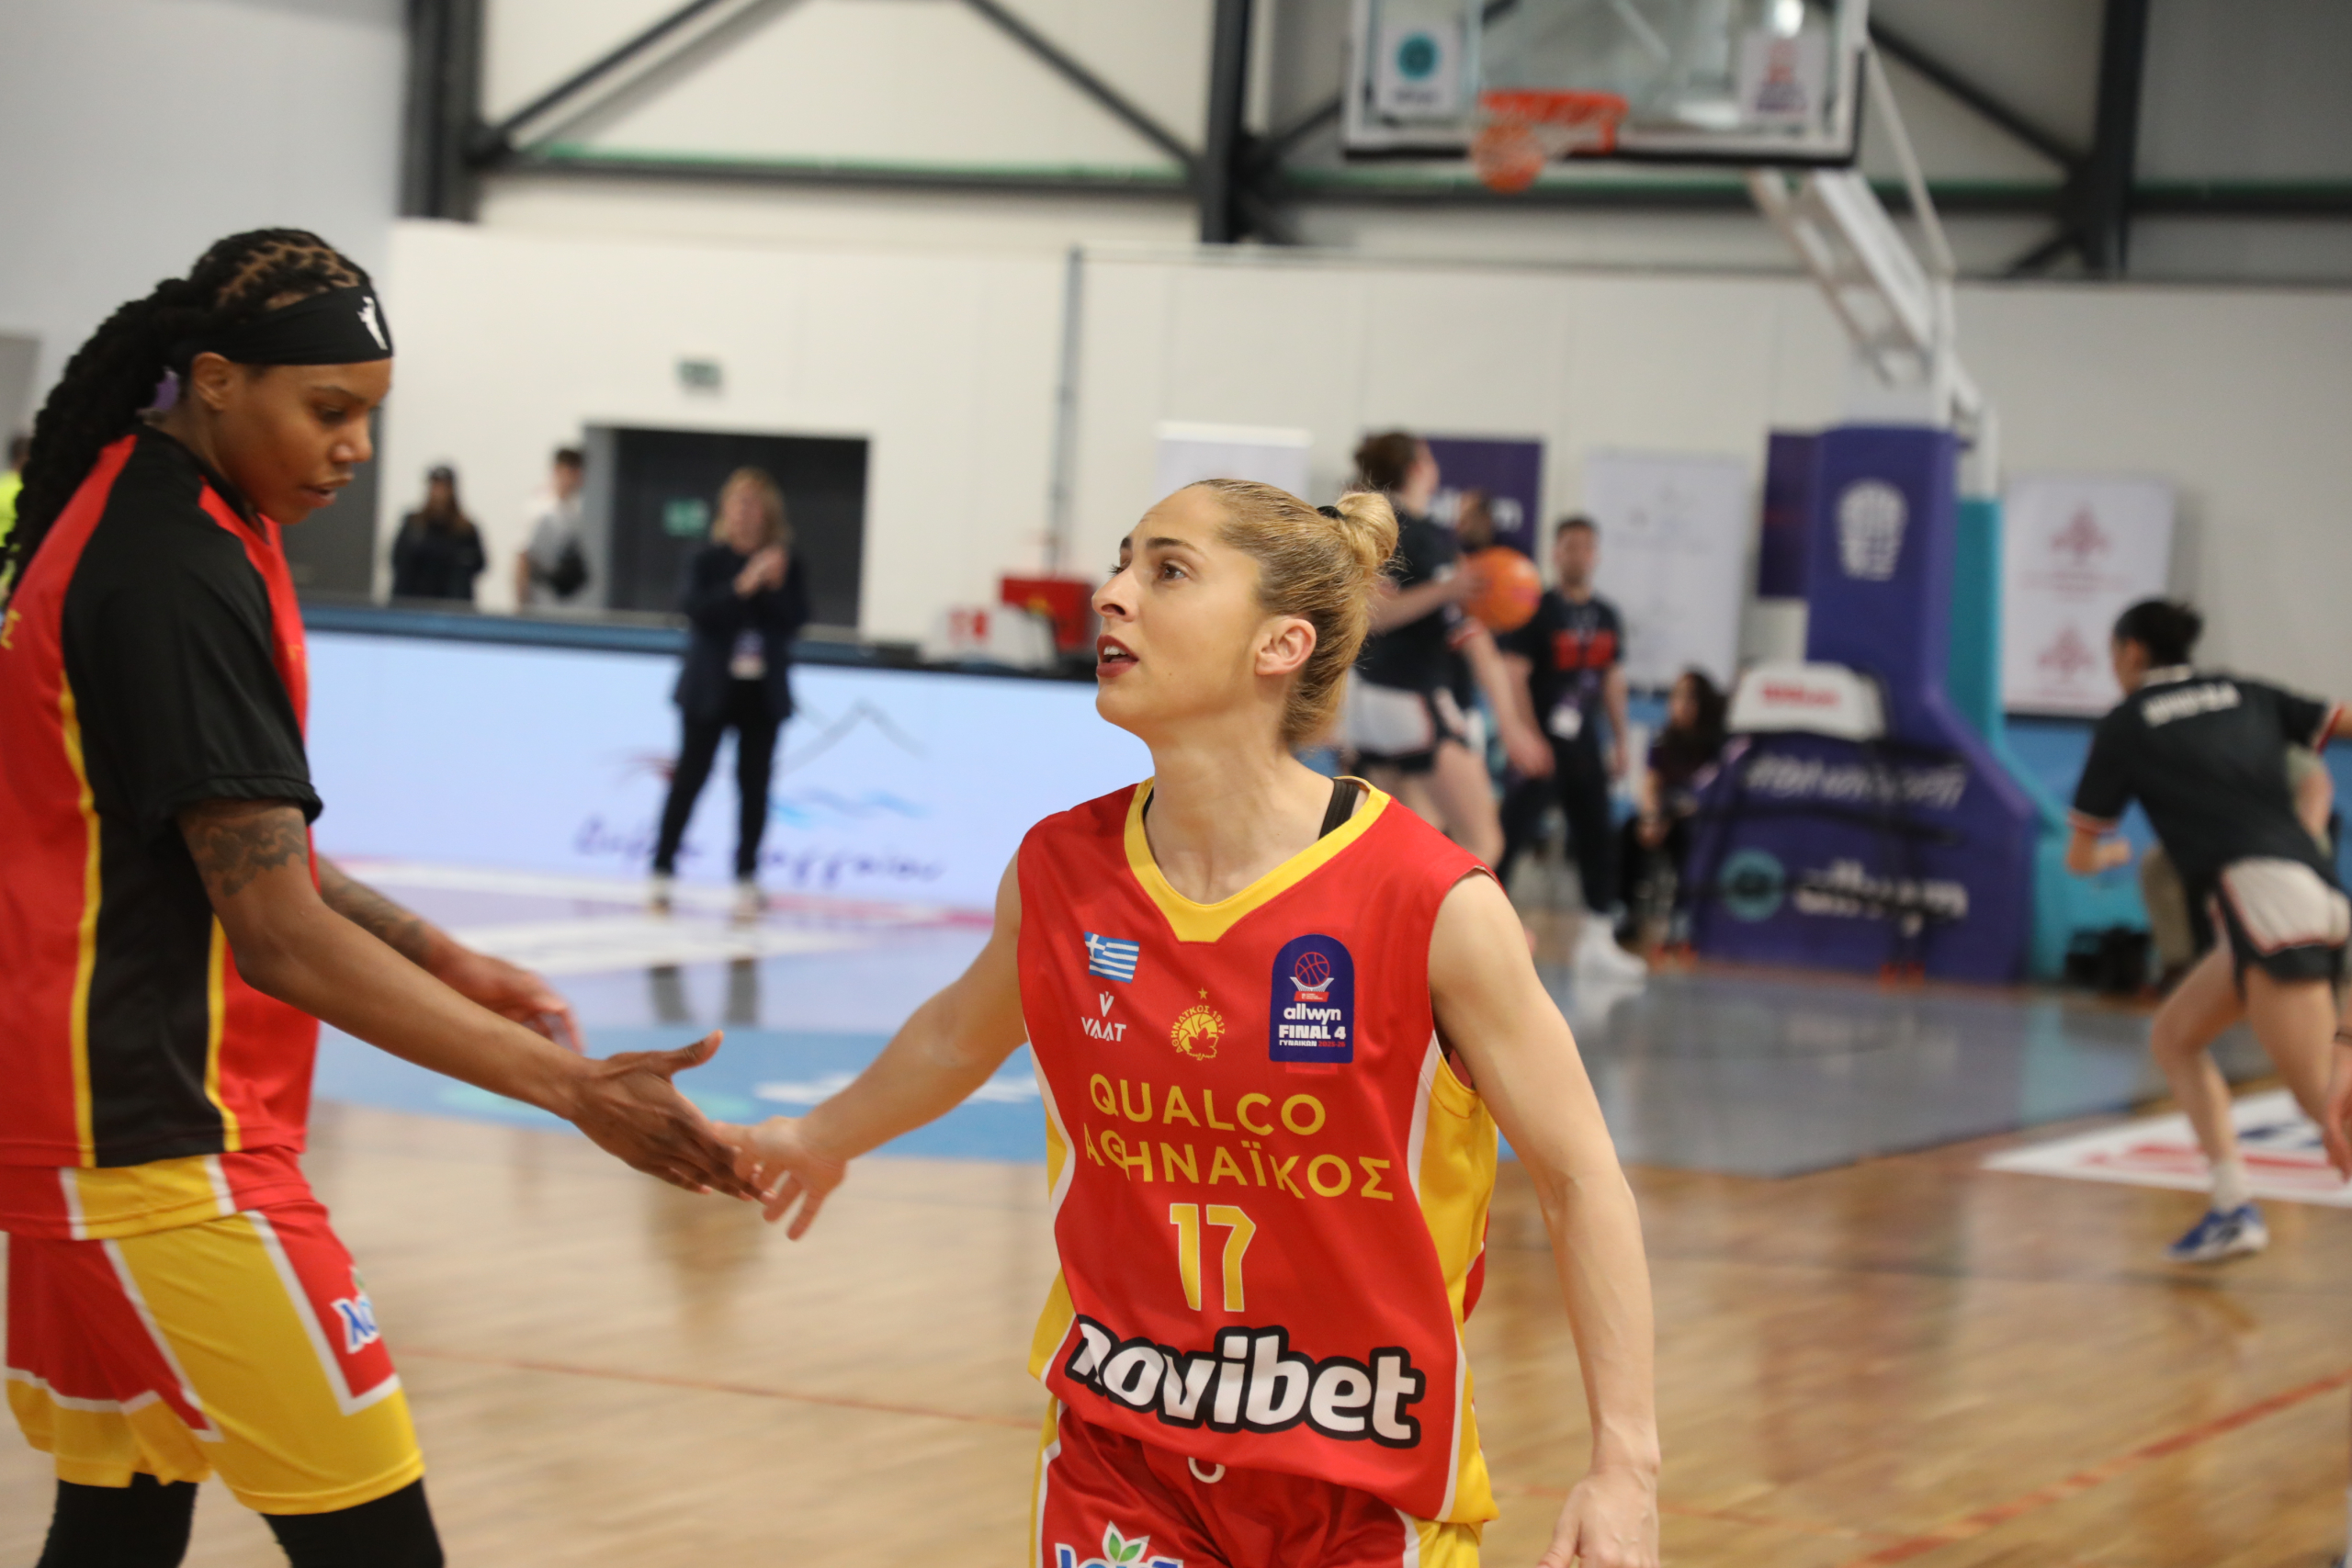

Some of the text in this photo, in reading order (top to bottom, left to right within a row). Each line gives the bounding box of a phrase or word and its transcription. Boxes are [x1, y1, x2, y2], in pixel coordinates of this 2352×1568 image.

[1213, 1010, 1226, 1034] 1917
[1283, 1003, 1341, 1025] allwyn
[1080, 1016, 1127, 1043] VAAT
[1278, 1024, 1347, 1040] FINAL 4
[1090, 1073, 1327, 1136] QUALCO
[1170, 1202, 1257, 1313] 17
